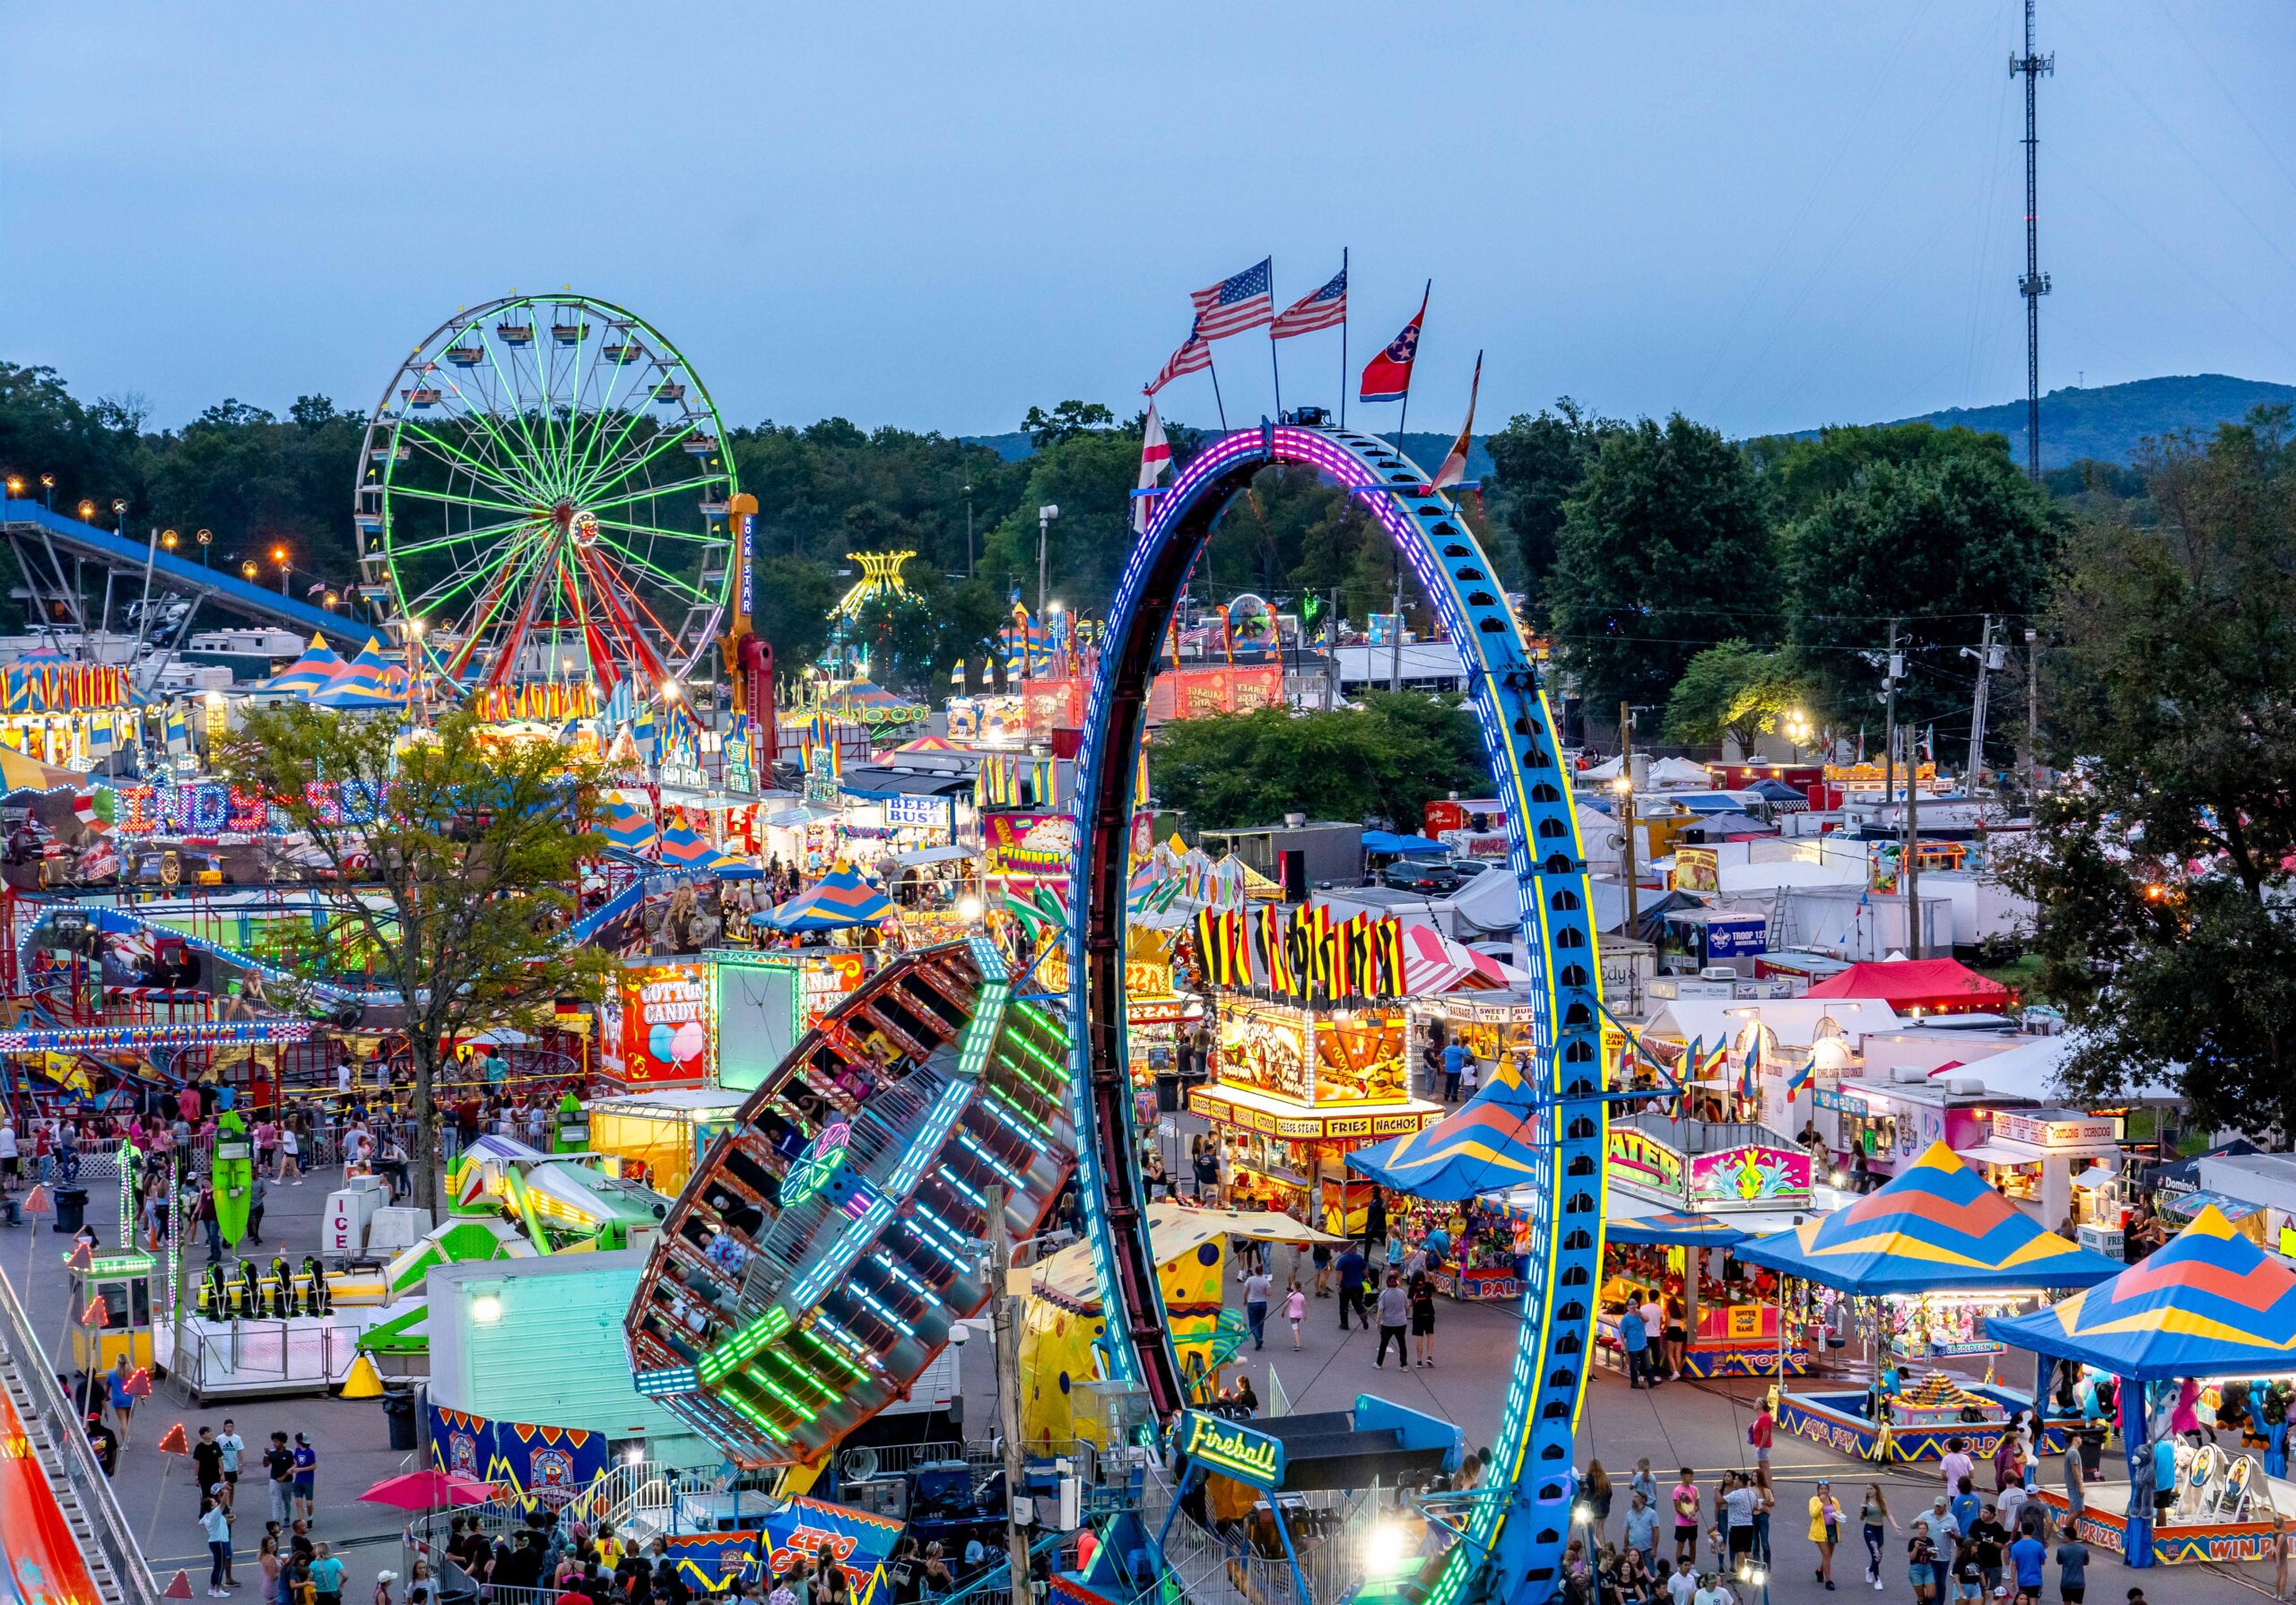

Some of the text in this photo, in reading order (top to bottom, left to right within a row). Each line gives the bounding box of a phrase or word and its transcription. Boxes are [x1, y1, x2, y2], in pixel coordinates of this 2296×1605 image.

[744, 517, 752, 556] ROCK
[744, 565, 752, 612] STAR
[890, 812, 939, 824] BUST
[997, 845, 1063, 874] FUNNEL
[1732, 930, 1766, 940] TROOP 127
[807, 971, 843, 992] NDY
[1126, 968, 1161, 992] ZZA
[1449, 1005, 1472, 1019] SAUSAGE
[58, 1028, 237, 1046] INDY RACING
[1278, 1122, 1319, 1133] CHEESE STEAK
[1331, 1121, 1367, 1133] FRIES
[1376, 1118, 1416, 1131] NACHOS
[2083, 1126, 2111, 1138] CORNDOG
[1607, 1132, 1683, 1194] ATER
[2165, 1176, 2198, 1193] Domino's
[334, 1199, 348, 1249] ICE
[2083, 1231, 2098, 1245] FRESH
[2107, 1235, 2125, 1249] FRES
[1735, 1310, 1756, 1318] WATER
[1735, 1324, 1754, 1332] GAME
[1957, 1345, 1974, 1353] GOLD
[1975, 1344, 1990, 1352] FISH
[1804, 1417, 1854, 1446] GOLD FISH
[1187, 1412, 1276, 1472] Fireball
[787, 1523, 858, 1562] ZERO
[2082, 1523, 2123, 1551] PRIZES
[2210, 1539, 2255, 1560] WIN
[769, 1548, 874, 1594] GRTY
